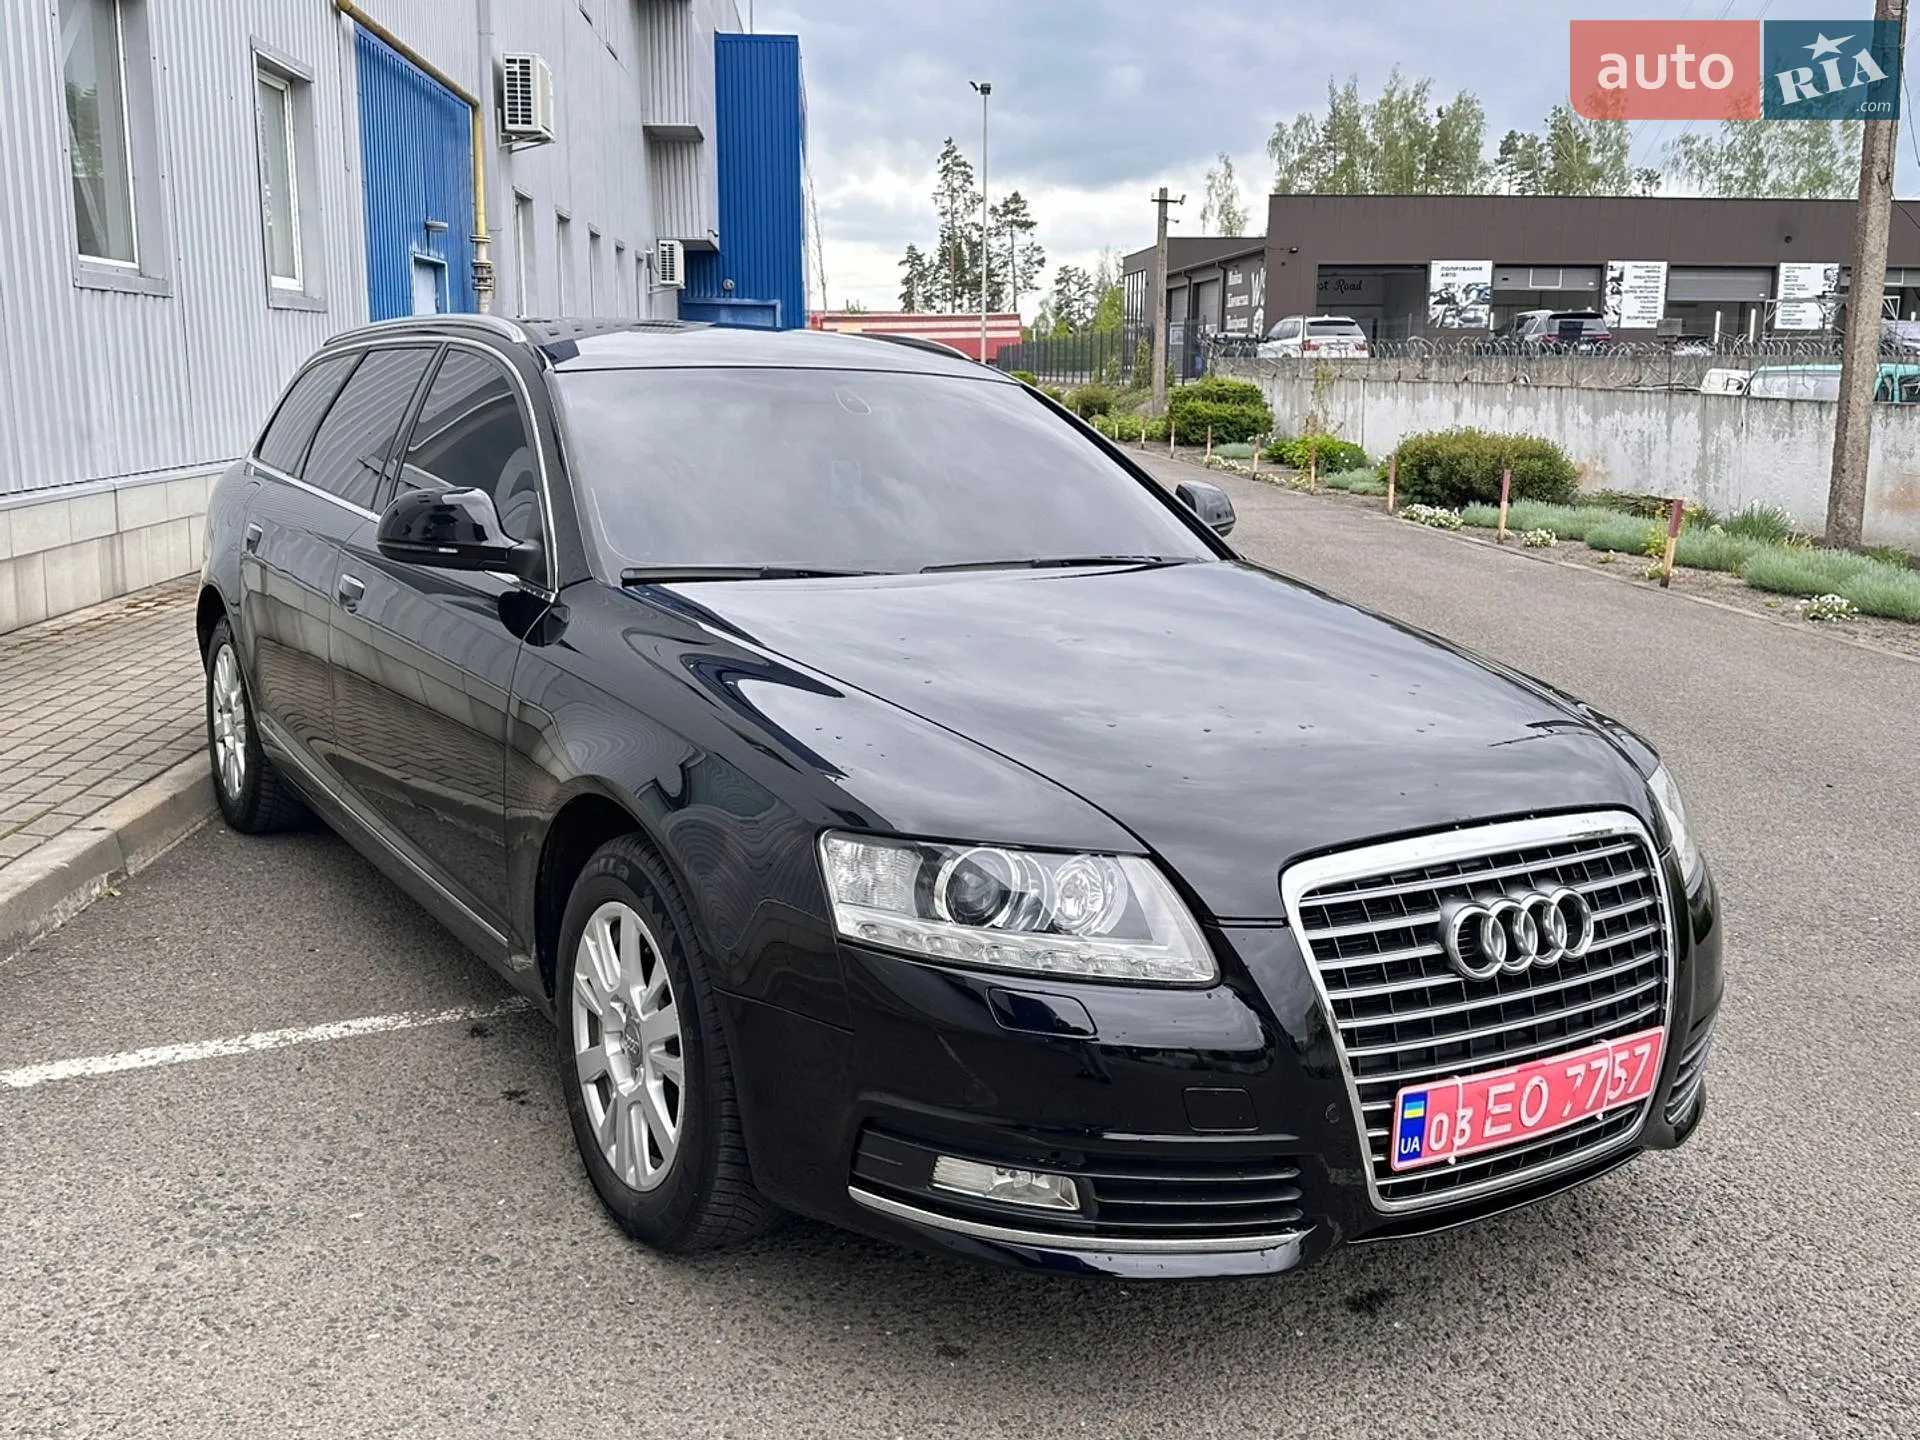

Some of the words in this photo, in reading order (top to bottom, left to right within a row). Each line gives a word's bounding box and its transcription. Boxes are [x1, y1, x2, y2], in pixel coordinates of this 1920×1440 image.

[1333, 278, 1363, 294] Road
[1429, 1107, 1474, 1151] 03
[1482, 1074, 1549, 1138] EO
[1560, 1043, 1652, 1118] 7757
[1401, 1136, 1421, 1154] UA
